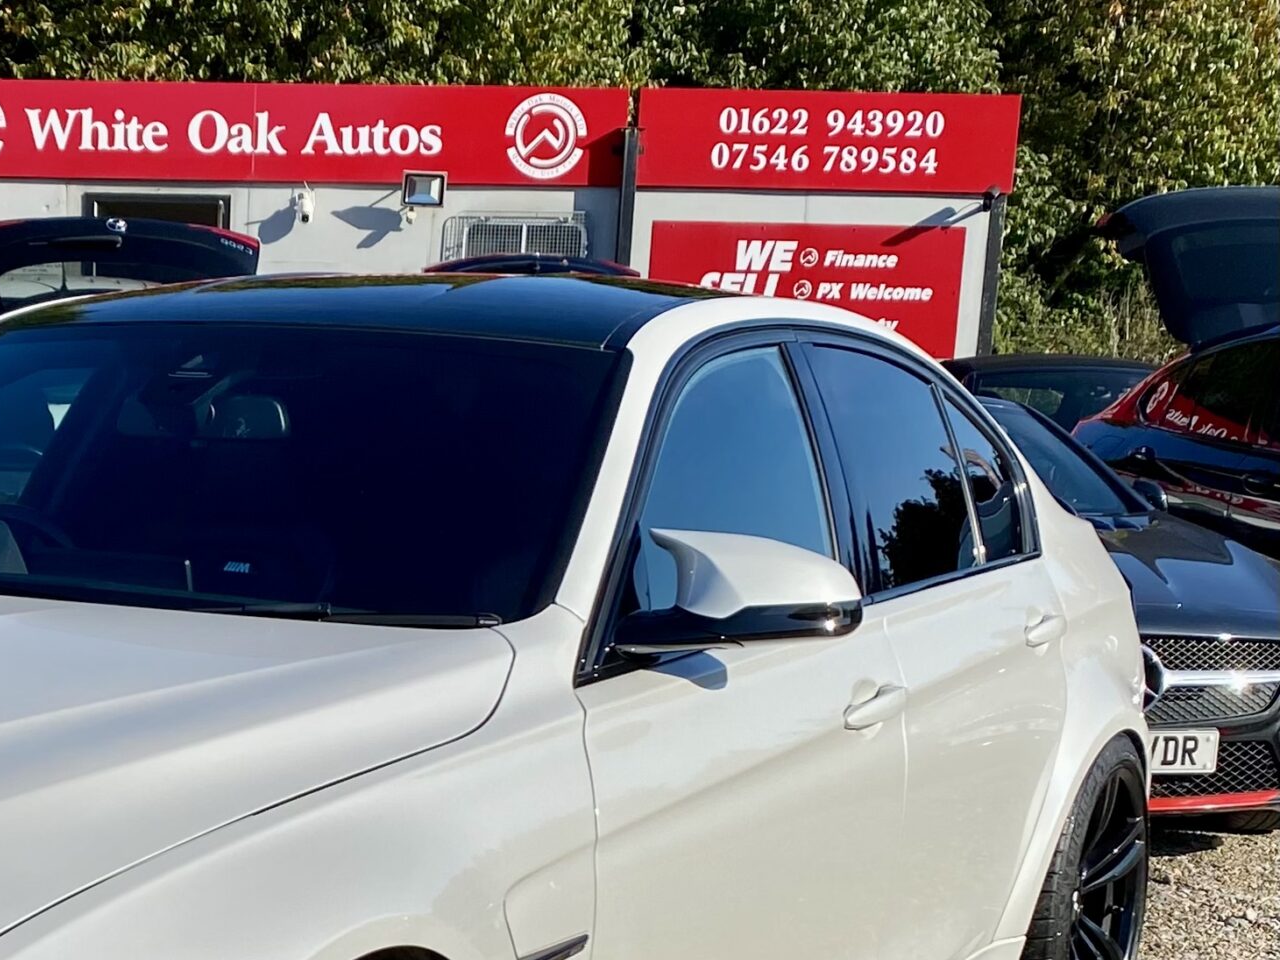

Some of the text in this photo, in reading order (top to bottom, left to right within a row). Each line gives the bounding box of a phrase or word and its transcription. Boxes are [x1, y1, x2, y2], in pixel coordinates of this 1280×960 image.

[24, 108, 443, 155] White Oak Autos
[719, 107, 946, 138] 01622 943920
[710, 142, 939, 175] 07546 789584
[735, 239, 799, 272] WE
[823, 250, 899, 269] Finance
[816, 283, 934, 302] PX Welcome
[1152, 735, 1200, 766] DR
